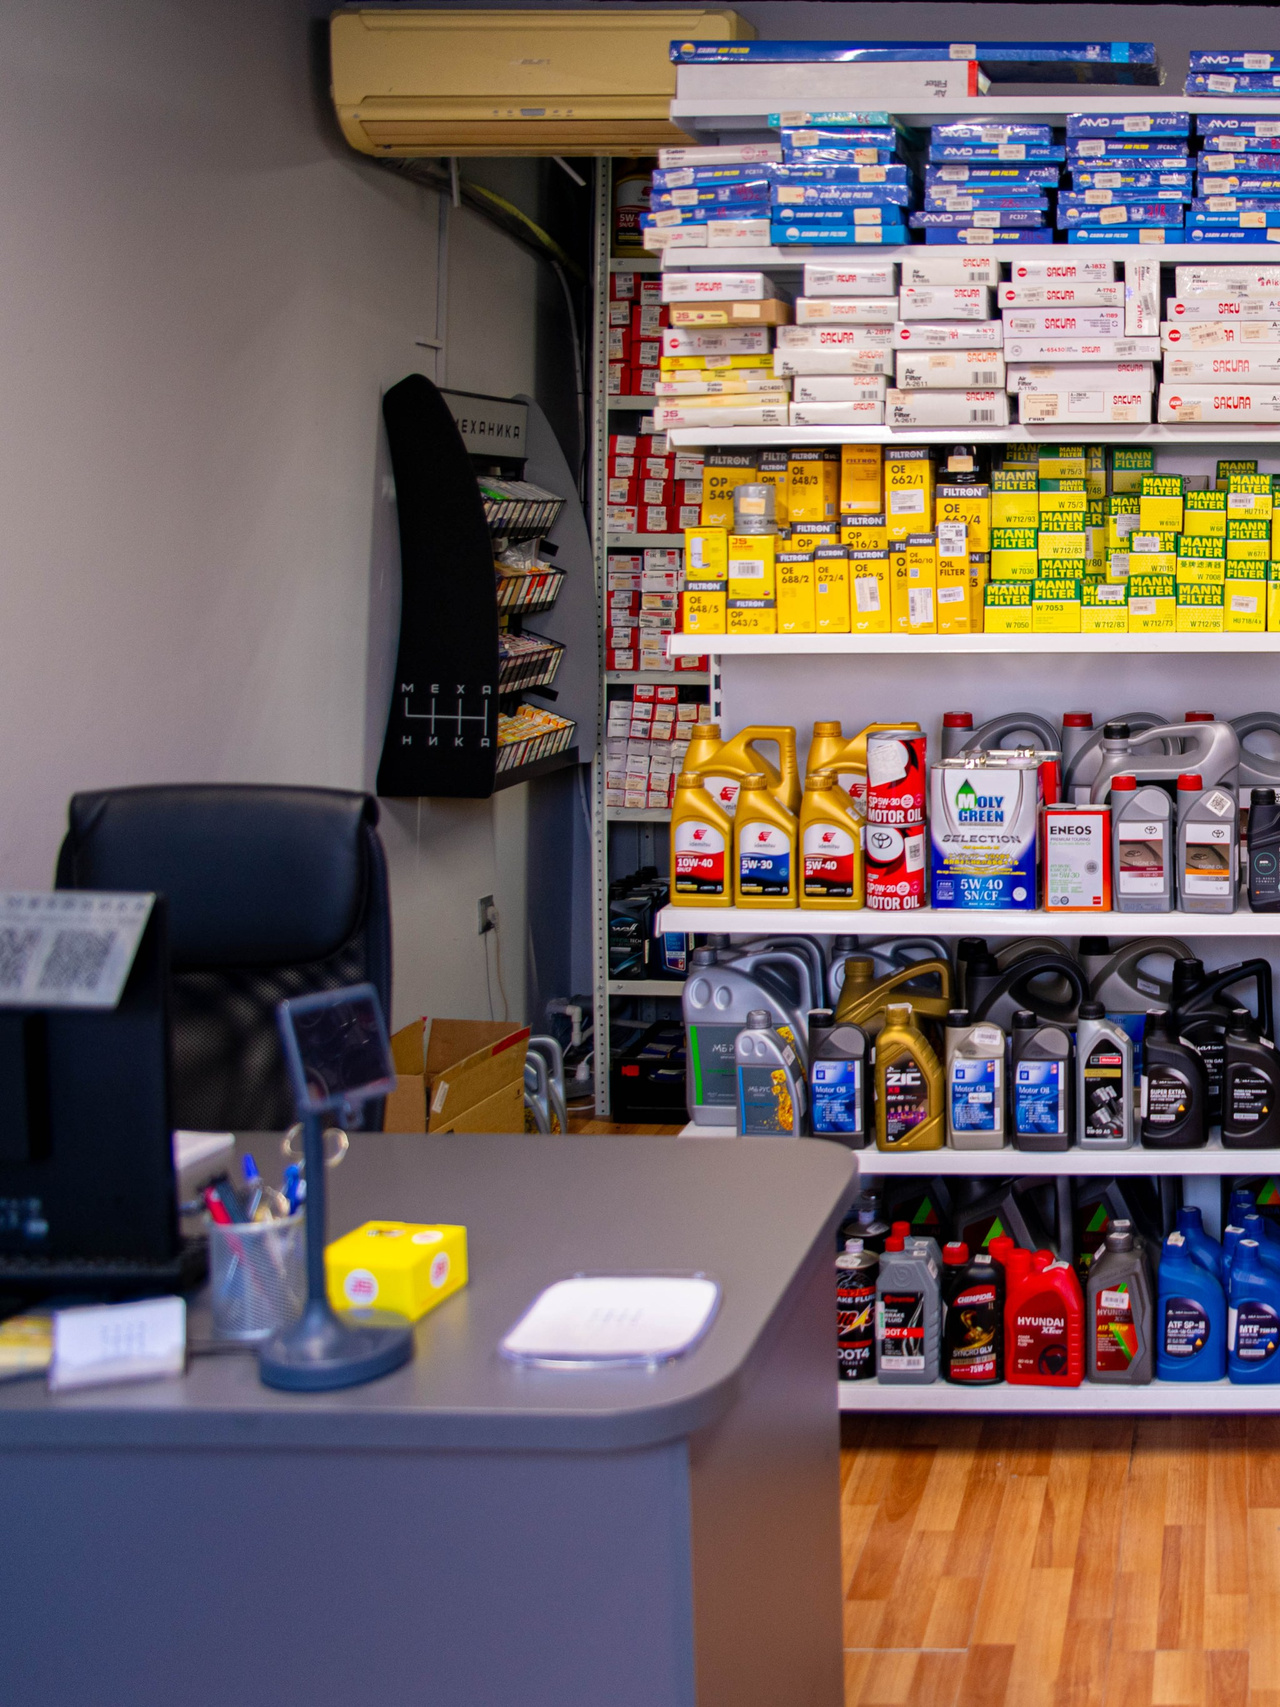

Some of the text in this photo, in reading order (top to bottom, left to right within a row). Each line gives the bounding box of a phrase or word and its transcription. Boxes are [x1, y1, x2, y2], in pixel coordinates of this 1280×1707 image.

[1199, 55, 1230, 64] AMD
[1079, 118, 1110, 127] AMD
[1047, 267, 1076, 277] SAKURA
[954, 289, 980, 298] SAKURA
[1047, 290, 1075, 301] SAKURA
[820, 332, 854, 344] SAKURA
[967, 352, 997, 363] SAKURA
[1213, 360, 1249, 372] SAKURA
[1213, 396, 1251, 410] SAKURA
[890, 450, 926, 459] FILTRON
[710, 456, 750, 466] FILTRON
[792, 467, 804, 475] OE
[891, 465, 906, 473] OE
[792, 475, 818, 485] 648/3
[891, 475, 924, 484] 662/1
[994, 472, 1036, 482] MANN
[994, 480, 1036, 490] FILTER
[1142, 478, 1180, 487] MANN
[943, 488, 982, 496] FILTRON
[1142, 487, 1180, 496] FILTER
[781, 575, 809, 584] 688/2
[818, 574, 844, 582] 672/4
[689, 596, 702, 604] OE
[689, 605, 719, 613] 648/5
[958, 792, 1004, 808] MOLY
[868, 809, 922, 823] MOTOR OIL
[958, 810, 1004, 822] GREEN
[1050, 826, 1092, 835] ENEOS
[942, 835, 1021, 844] SELECTION
[677, 859, 713, 868] 10W-40
[742, 860, 773, 870] 5W-30
[806, 861, 837, 870] 5W-40
[960, 879, 1003, 890] 5W-40
[964, 890, 998, 900] SN/CF
[887, 1073, 921, 1085] ZIC
[1018, 1316, 1064, 1327] HYUNDAI
